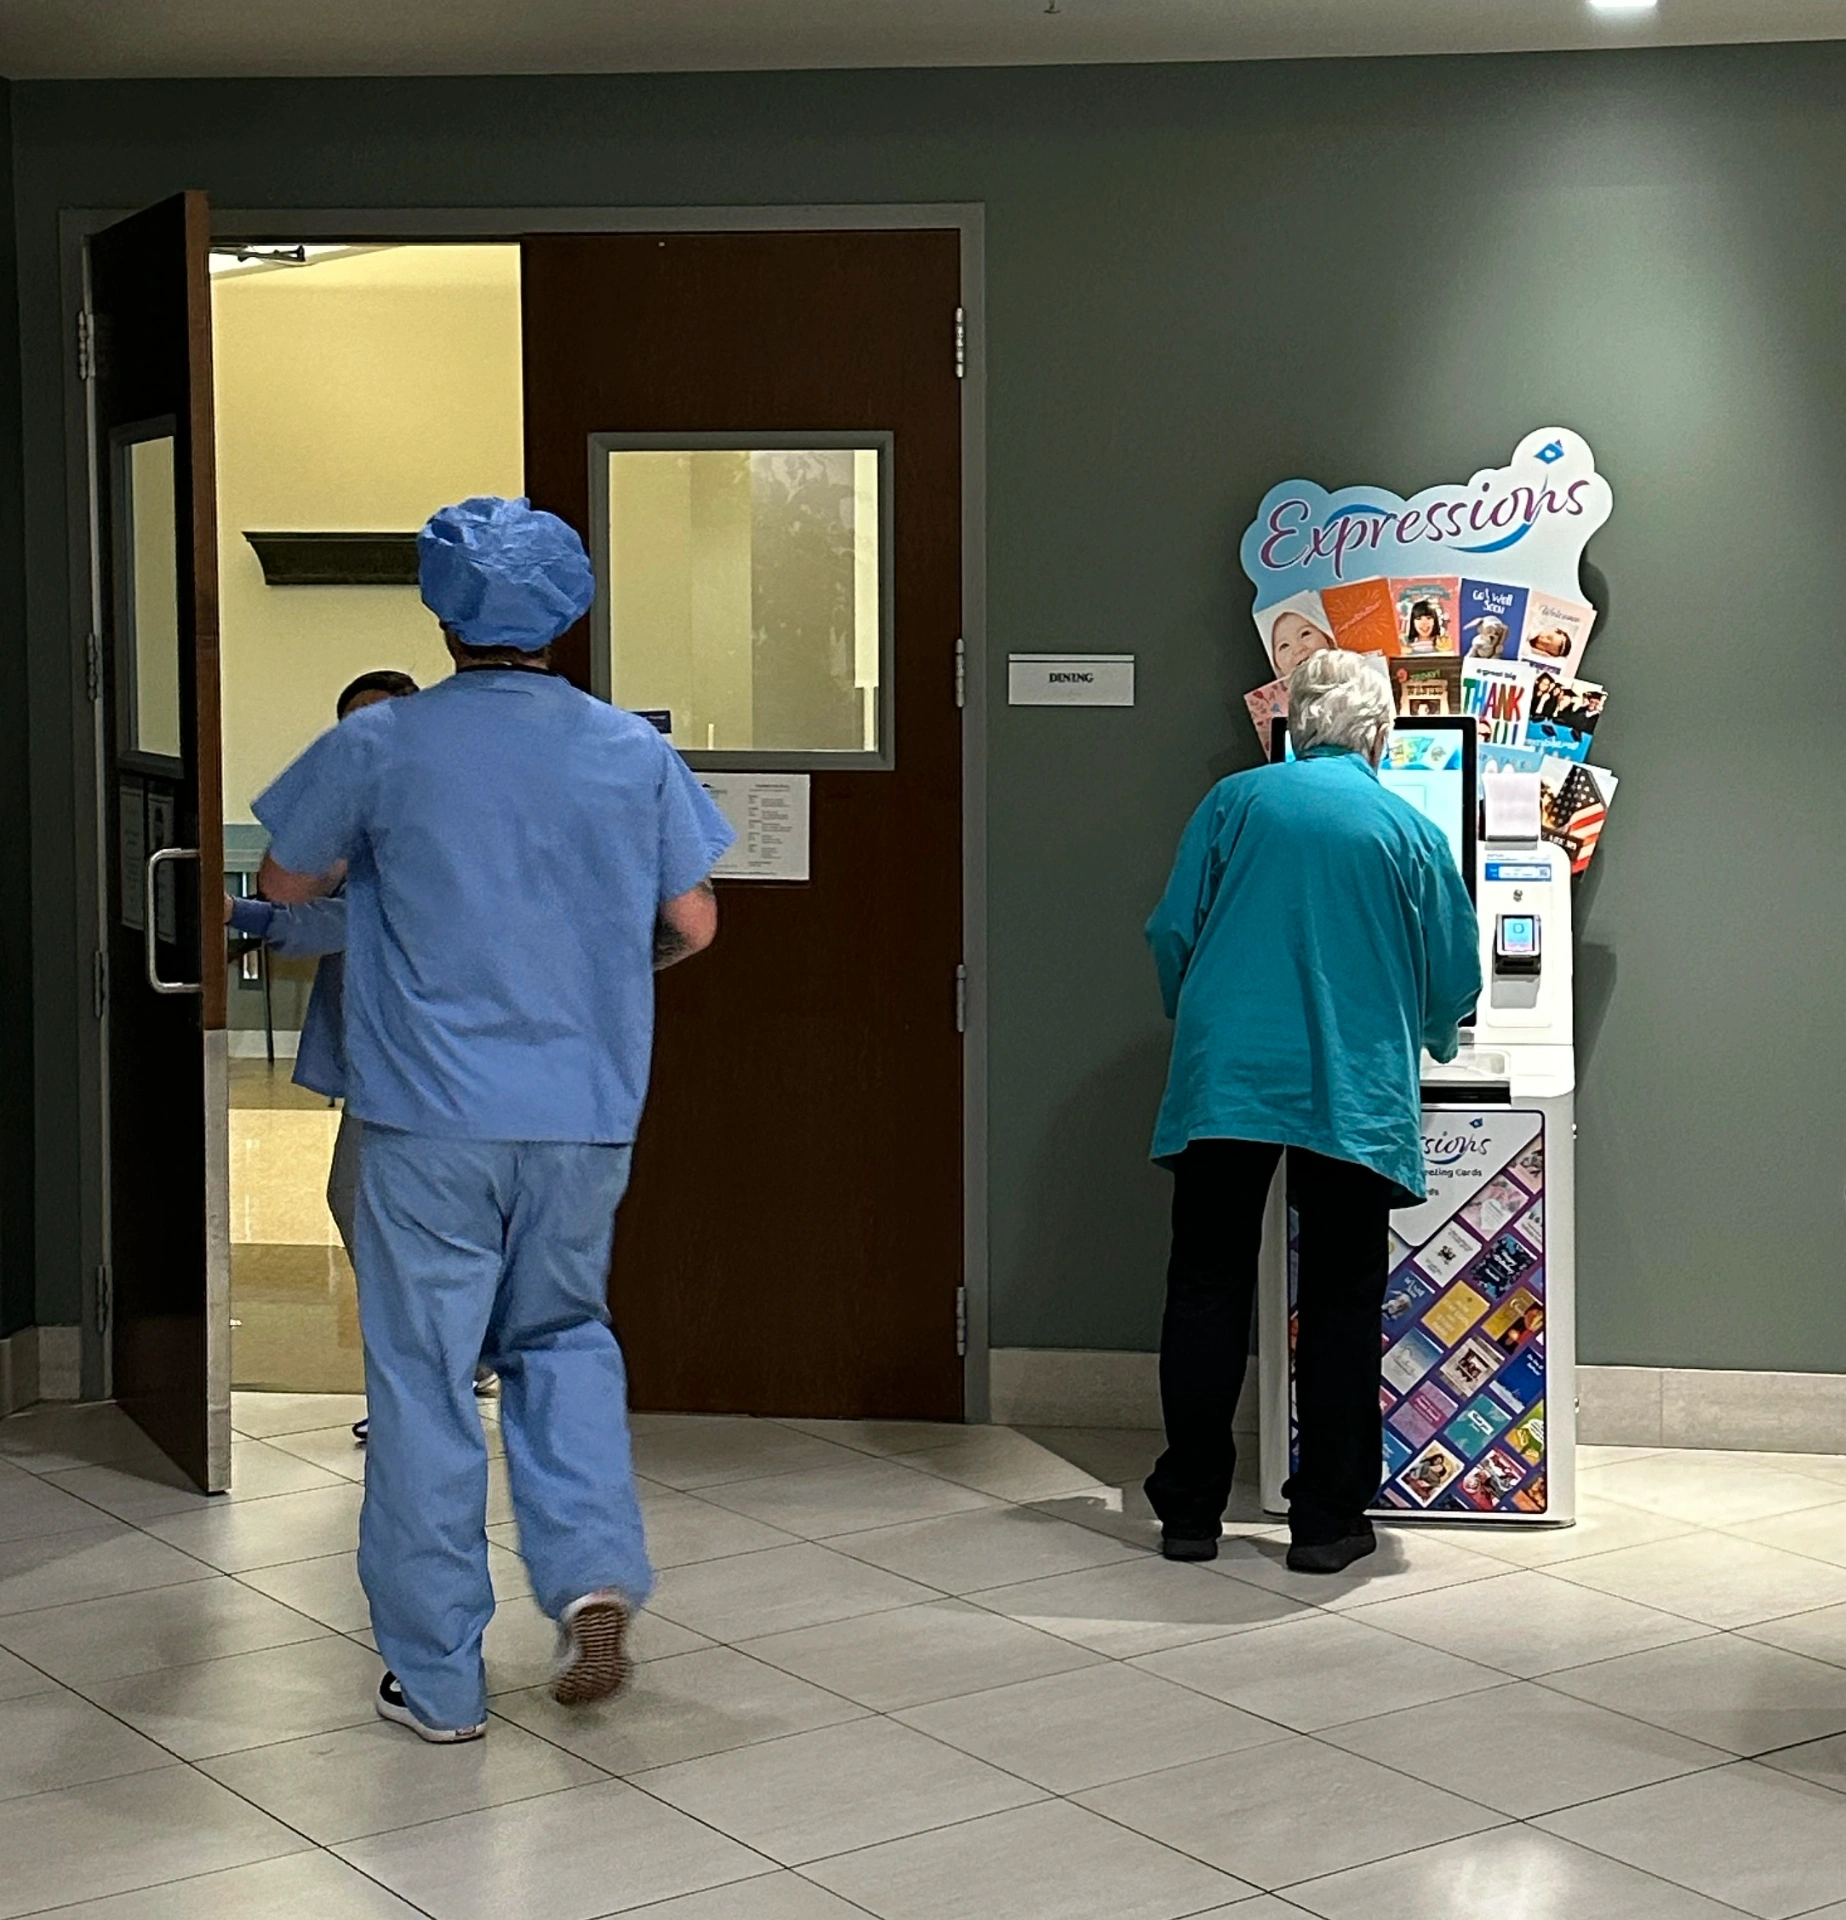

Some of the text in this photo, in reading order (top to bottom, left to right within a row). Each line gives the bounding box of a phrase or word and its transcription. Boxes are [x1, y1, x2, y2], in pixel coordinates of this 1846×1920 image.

[1260, 477, 1591, 578] Expressions
[1049, 672, 1094, 683] DINING
[1463, 678, 1524, 722] THANK
[1455, 1168, 1482, 1177] Cards
